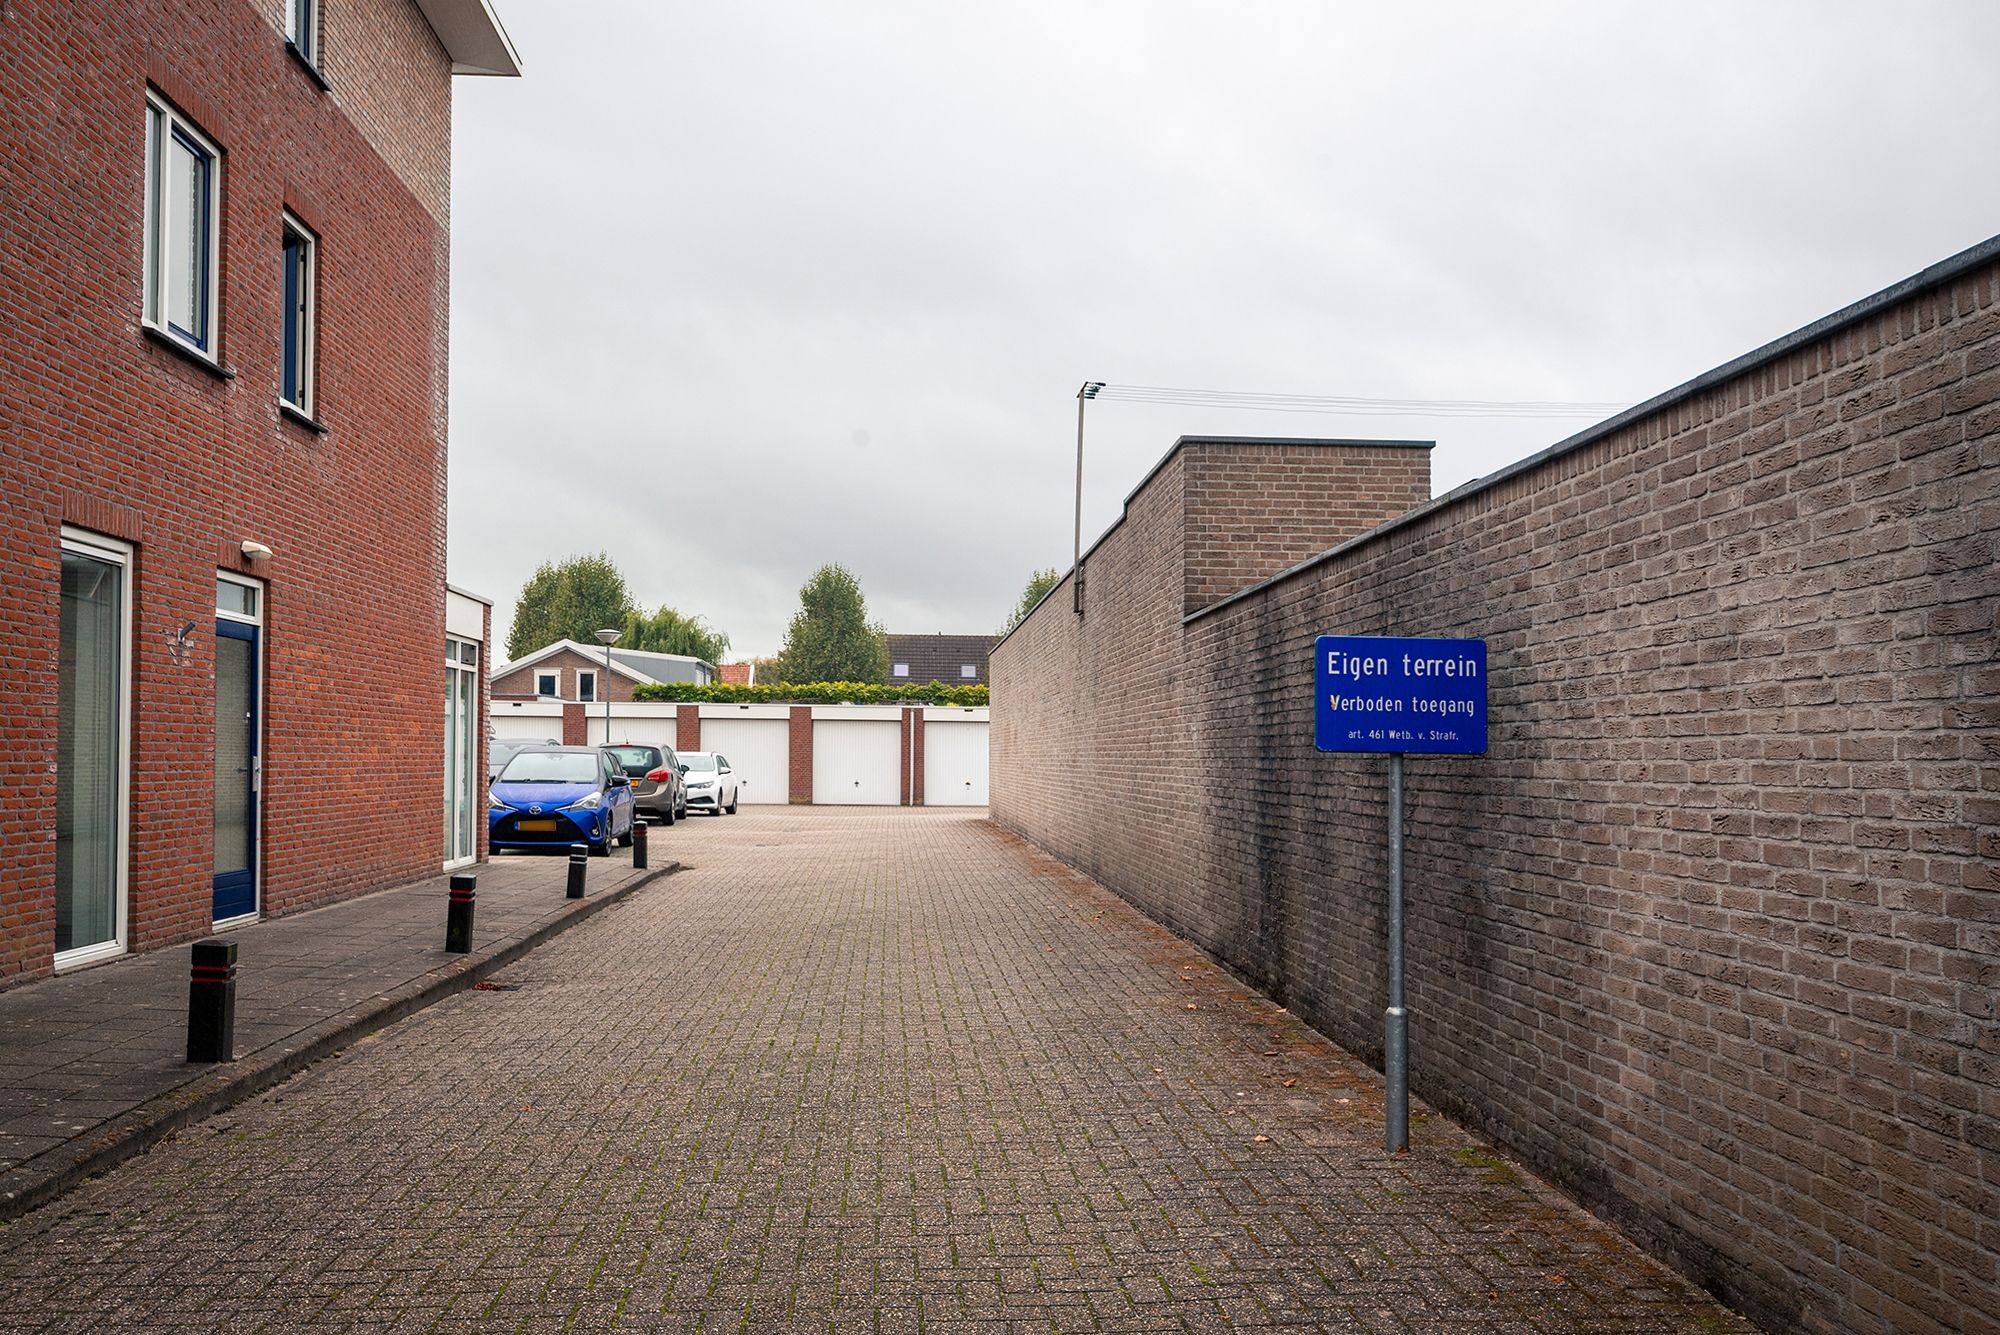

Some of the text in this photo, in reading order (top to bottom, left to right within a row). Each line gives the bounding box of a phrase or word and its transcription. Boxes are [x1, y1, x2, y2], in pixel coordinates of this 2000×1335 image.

[1327, 651, 1477, 681] Eigen terrein
[1330, 694, 1474, 717] Verboden toegang
[1348, 730, 1364, 739] art.
[1369, 730, 1385, 739] 461
[1388, 730, 1414, 740] Wetb.
[1430, 730, 1459, 741] Strafr.
